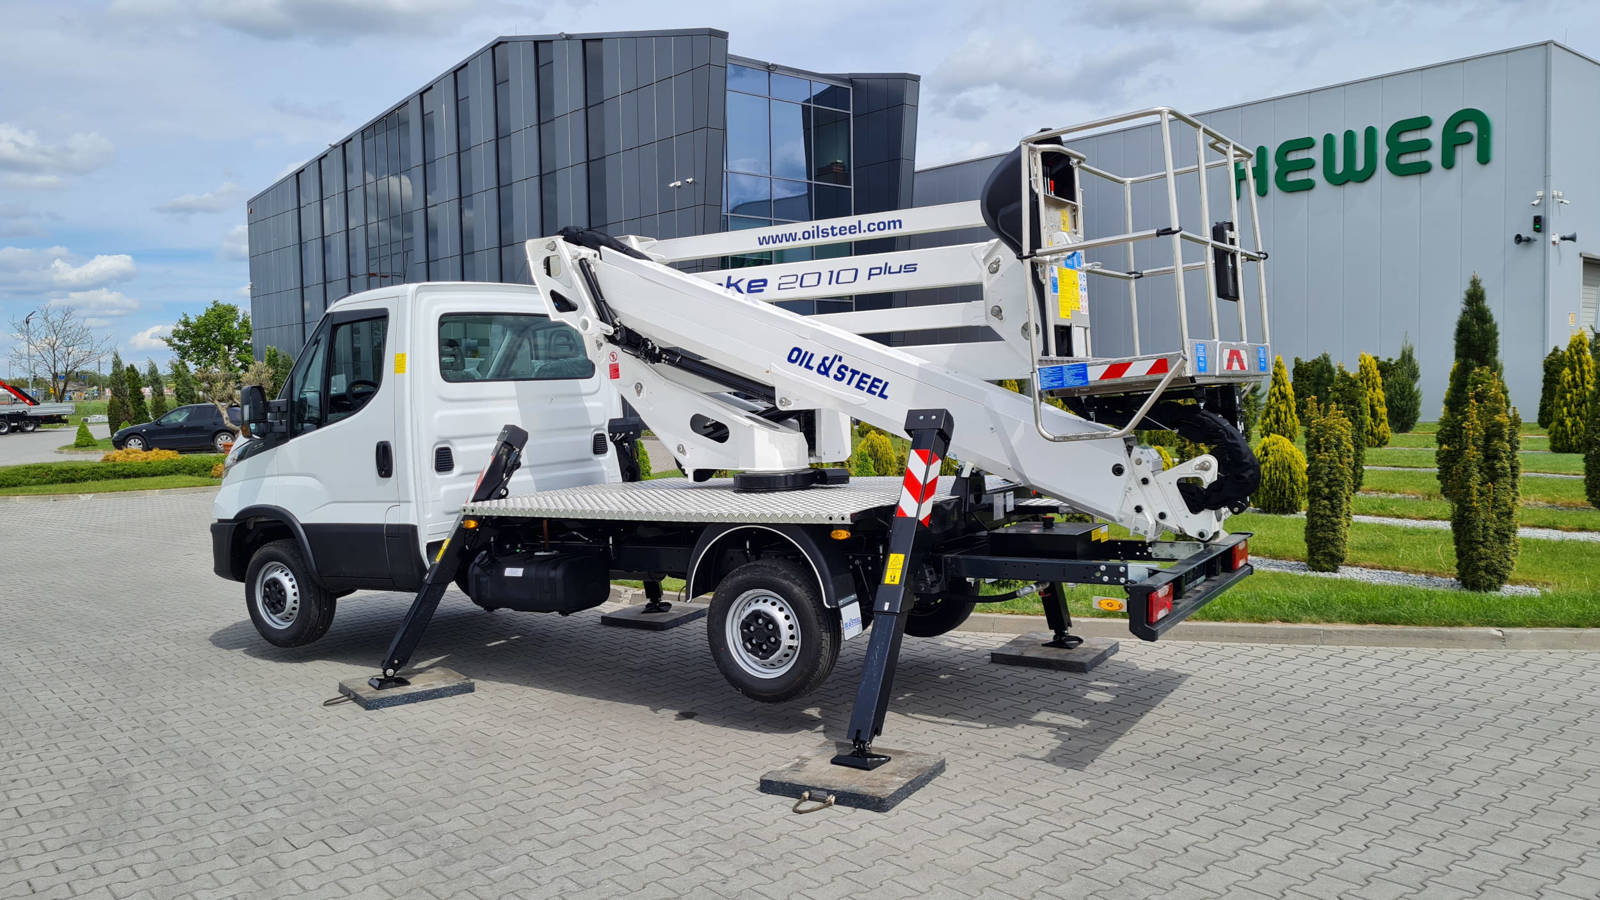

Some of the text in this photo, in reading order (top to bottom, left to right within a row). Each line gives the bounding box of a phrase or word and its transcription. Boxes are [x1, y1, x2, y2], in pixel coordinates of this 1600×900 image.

[1234, 108, 1493, 200] HEWEA
[757, 219, 903, 246] www.oilsteel.com
[716, 262, 918, 295] ke 2010 plus
